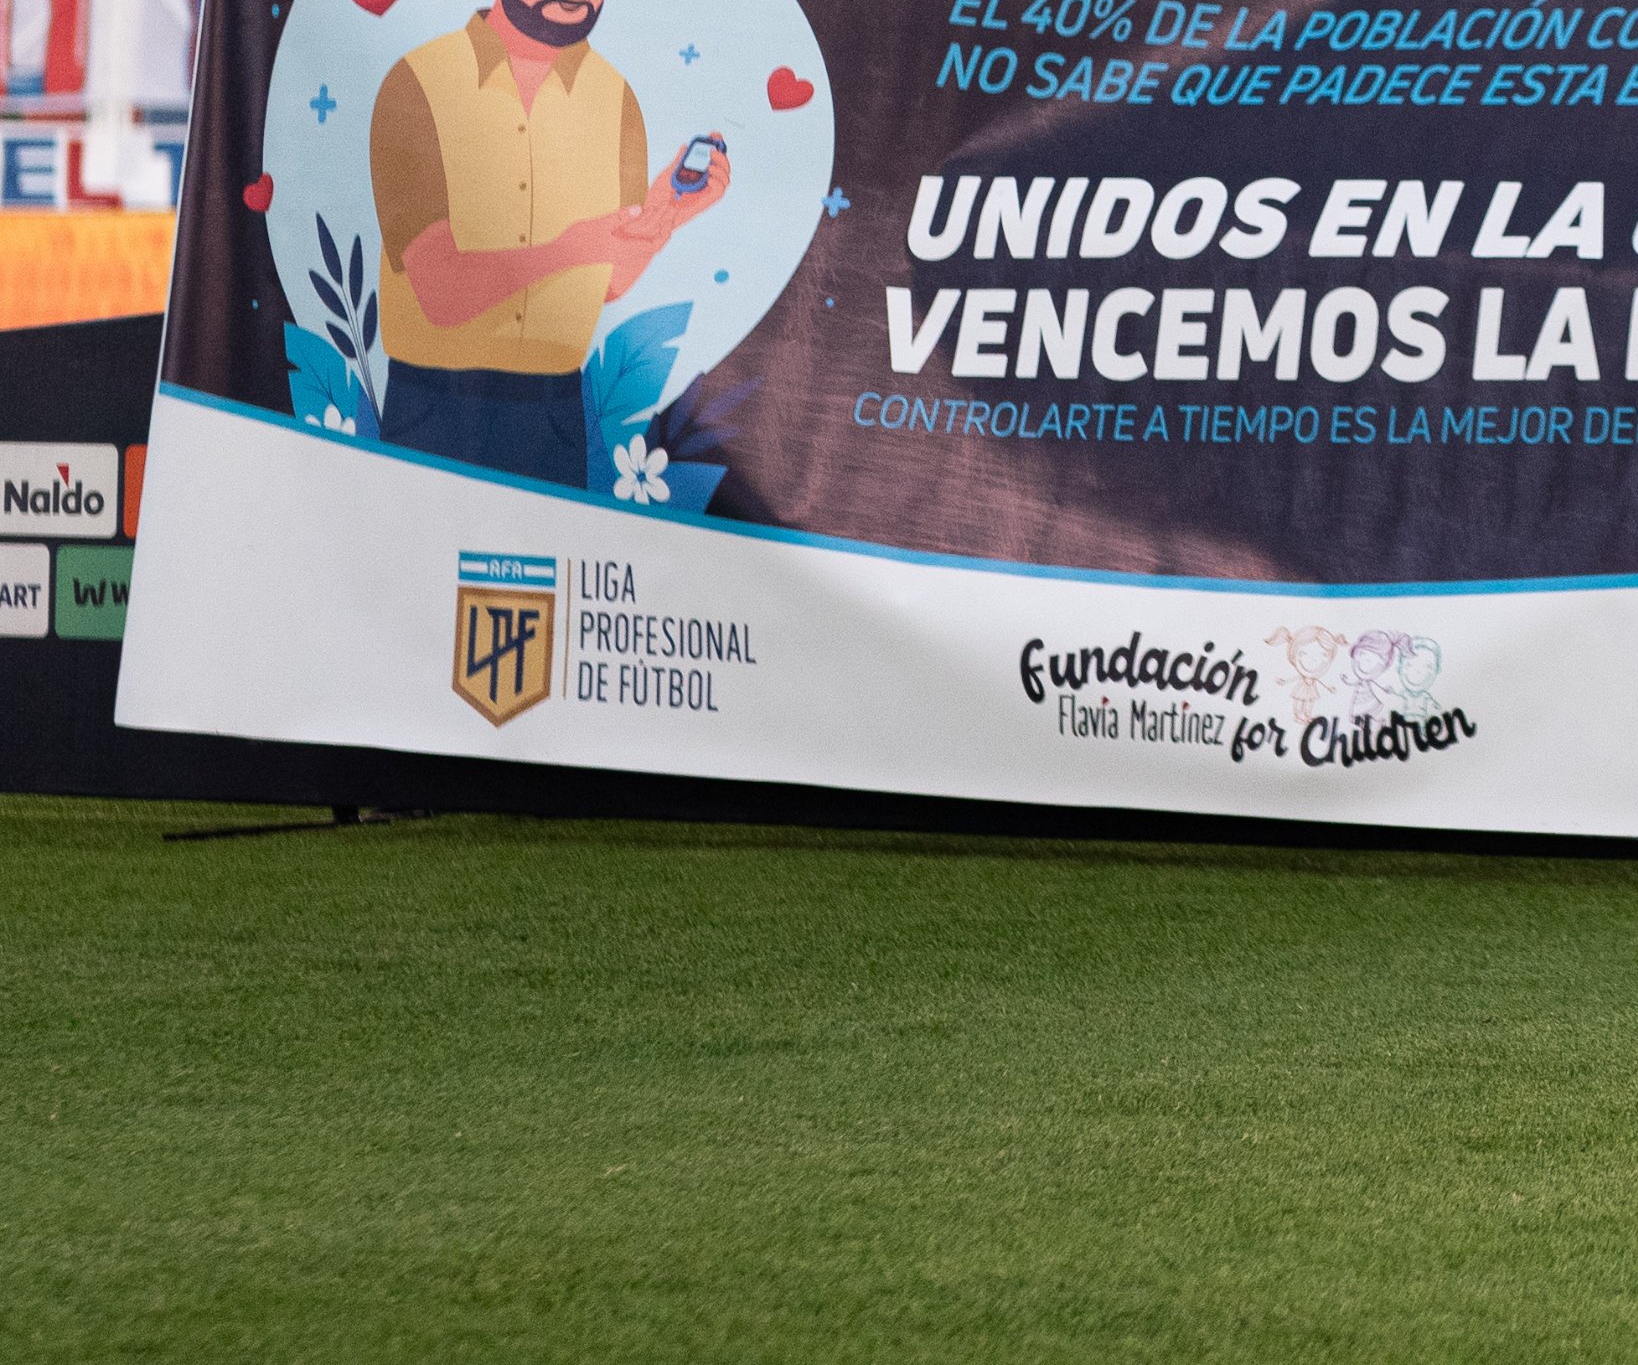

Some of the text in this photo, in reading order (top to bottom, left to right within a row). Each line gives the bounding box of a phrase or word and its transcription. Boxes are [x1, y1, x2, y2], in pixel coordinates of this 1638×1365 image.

[1146, 1, 1221, 47] DE
[1225, 7, 1287, 52] LA
[937, 43, 1018, 93] NO
[1026, 53, 1168, 105] SABE
[1170, 63, 1281, 107] QUE
[1279, 64, 1474, 107] PADECE
[1480, 64, 1608, 107] ESTA
[907, 175, 1301, 261] UNIDOS
[1308, 179, 1464, 258] EN
[1472, 181, 1604, 260] LA
[885, 286, 1450, 383] VENCEMOS
[1473, 287, 1600, 381] LA
[853, 391, 1137, 442] CONTROLARTE
[1142, 405, 1170, 442] A
[1178, 404, 1321, 444] TIEMPO
[1329, 405, 1377, 445] ES
[1386, 406, 1432, 444] LA
[1440, 405, 1574, 445] MEJOR
[3, 478, 105, 515] Naldo
[581, 561, 636, 603] LIGA
[580, 611, 758, 664] PROFESIONAL
[578, 658, 719, 712] DE FÚTBOL
[1058, 694, 1120, 740] Flavia
[1230, 706, 1477, 769] for Children
